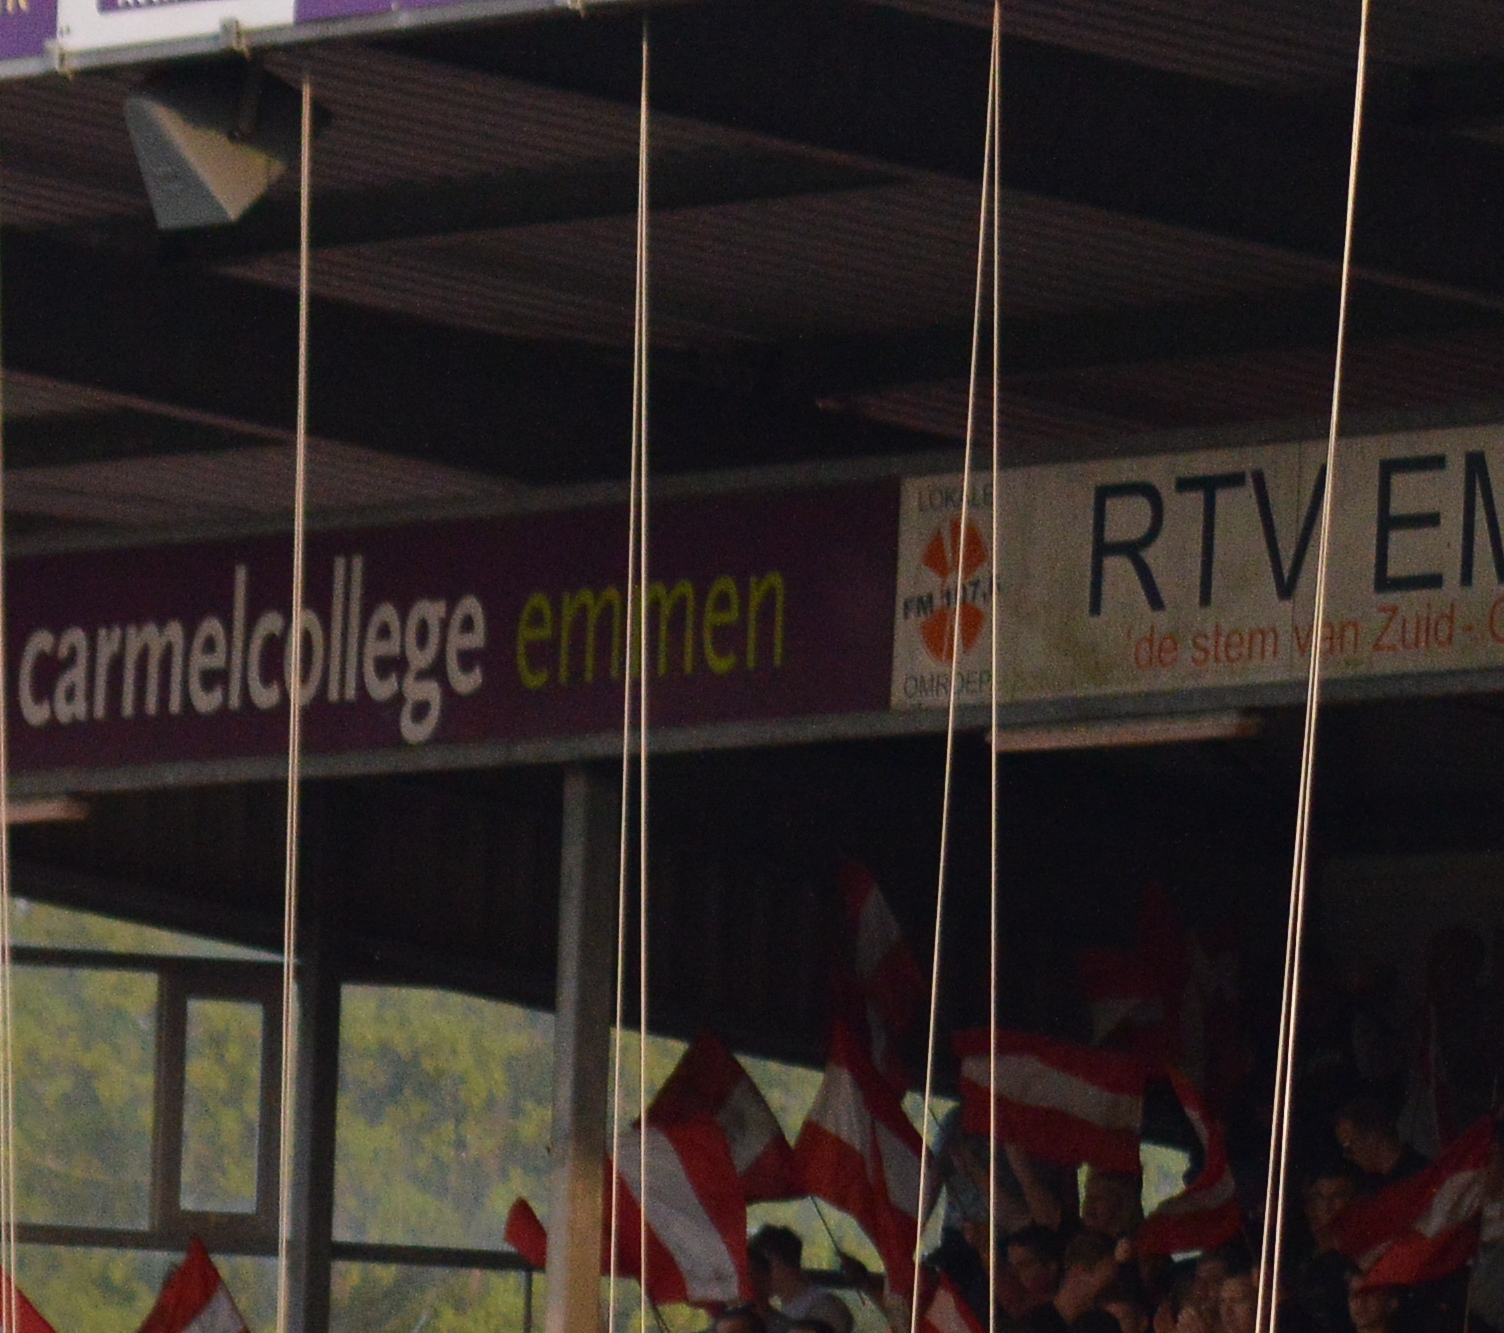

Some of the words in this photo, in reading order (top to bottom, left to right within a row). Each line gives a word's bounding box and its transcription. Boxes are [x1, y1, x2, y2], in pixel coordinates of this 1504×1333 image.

[1089, 462, 1330, 617] RTV
[18, 554, 486, 744] carmelcollege
[516, 570, 786, 691] emmen
[1192, 624, 1281, 667] stem
[1296, 616, 1360, 658] van
